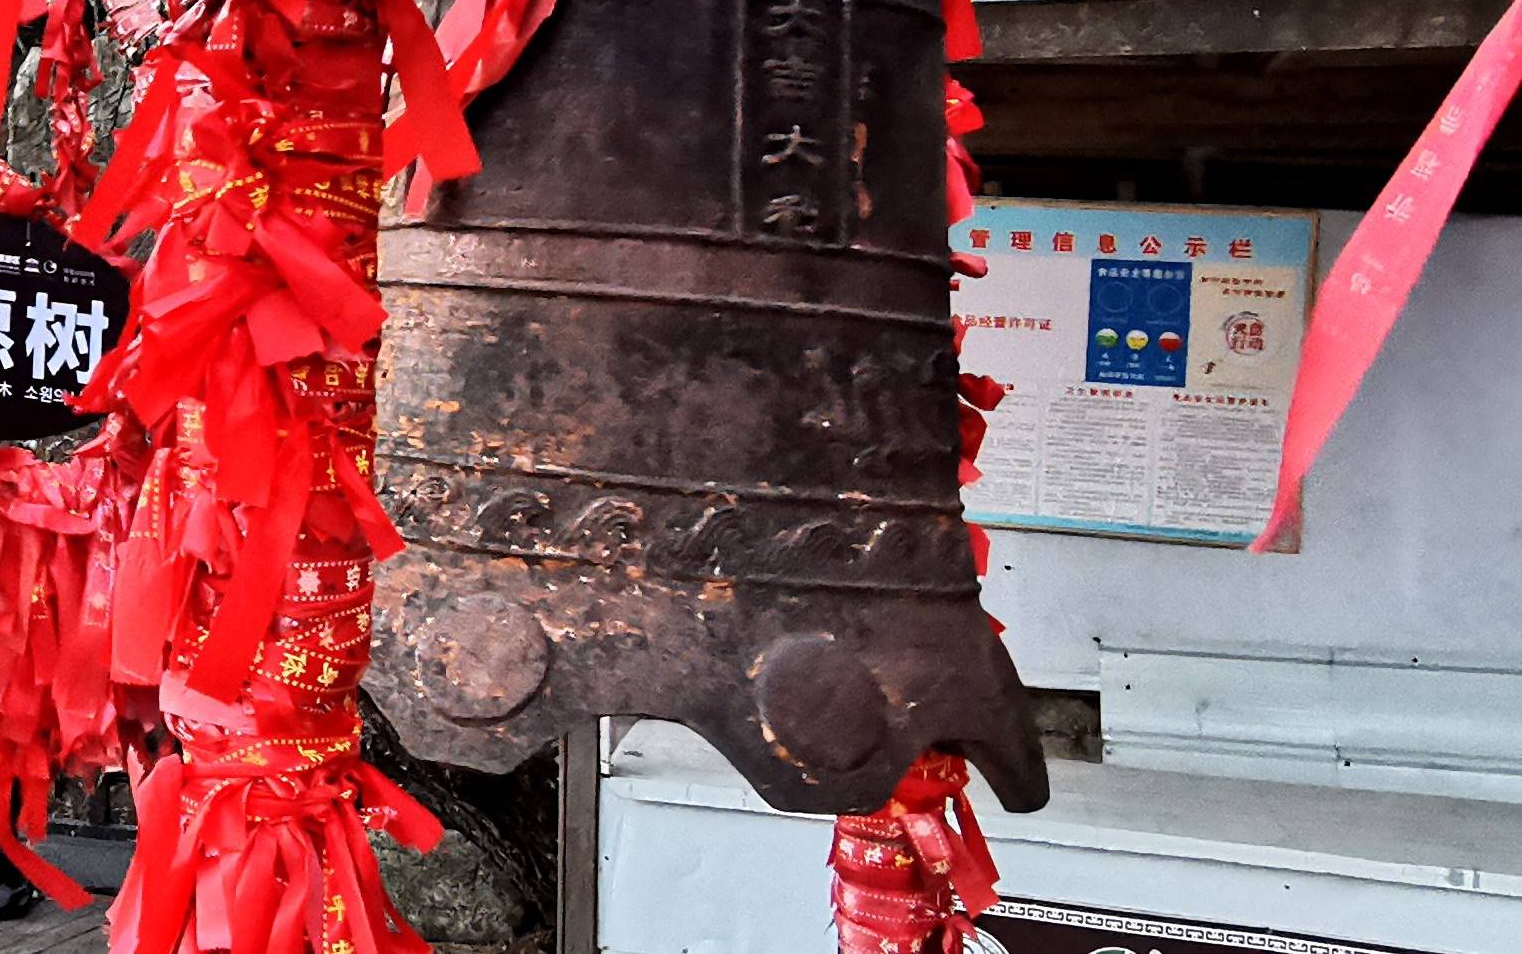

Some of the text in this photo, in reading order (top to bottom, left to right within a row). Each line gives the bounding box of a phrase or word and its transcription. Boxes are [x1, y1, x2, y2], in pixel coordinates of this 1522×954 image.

[968, 227, 1254, 259] 管理信息公示栏
